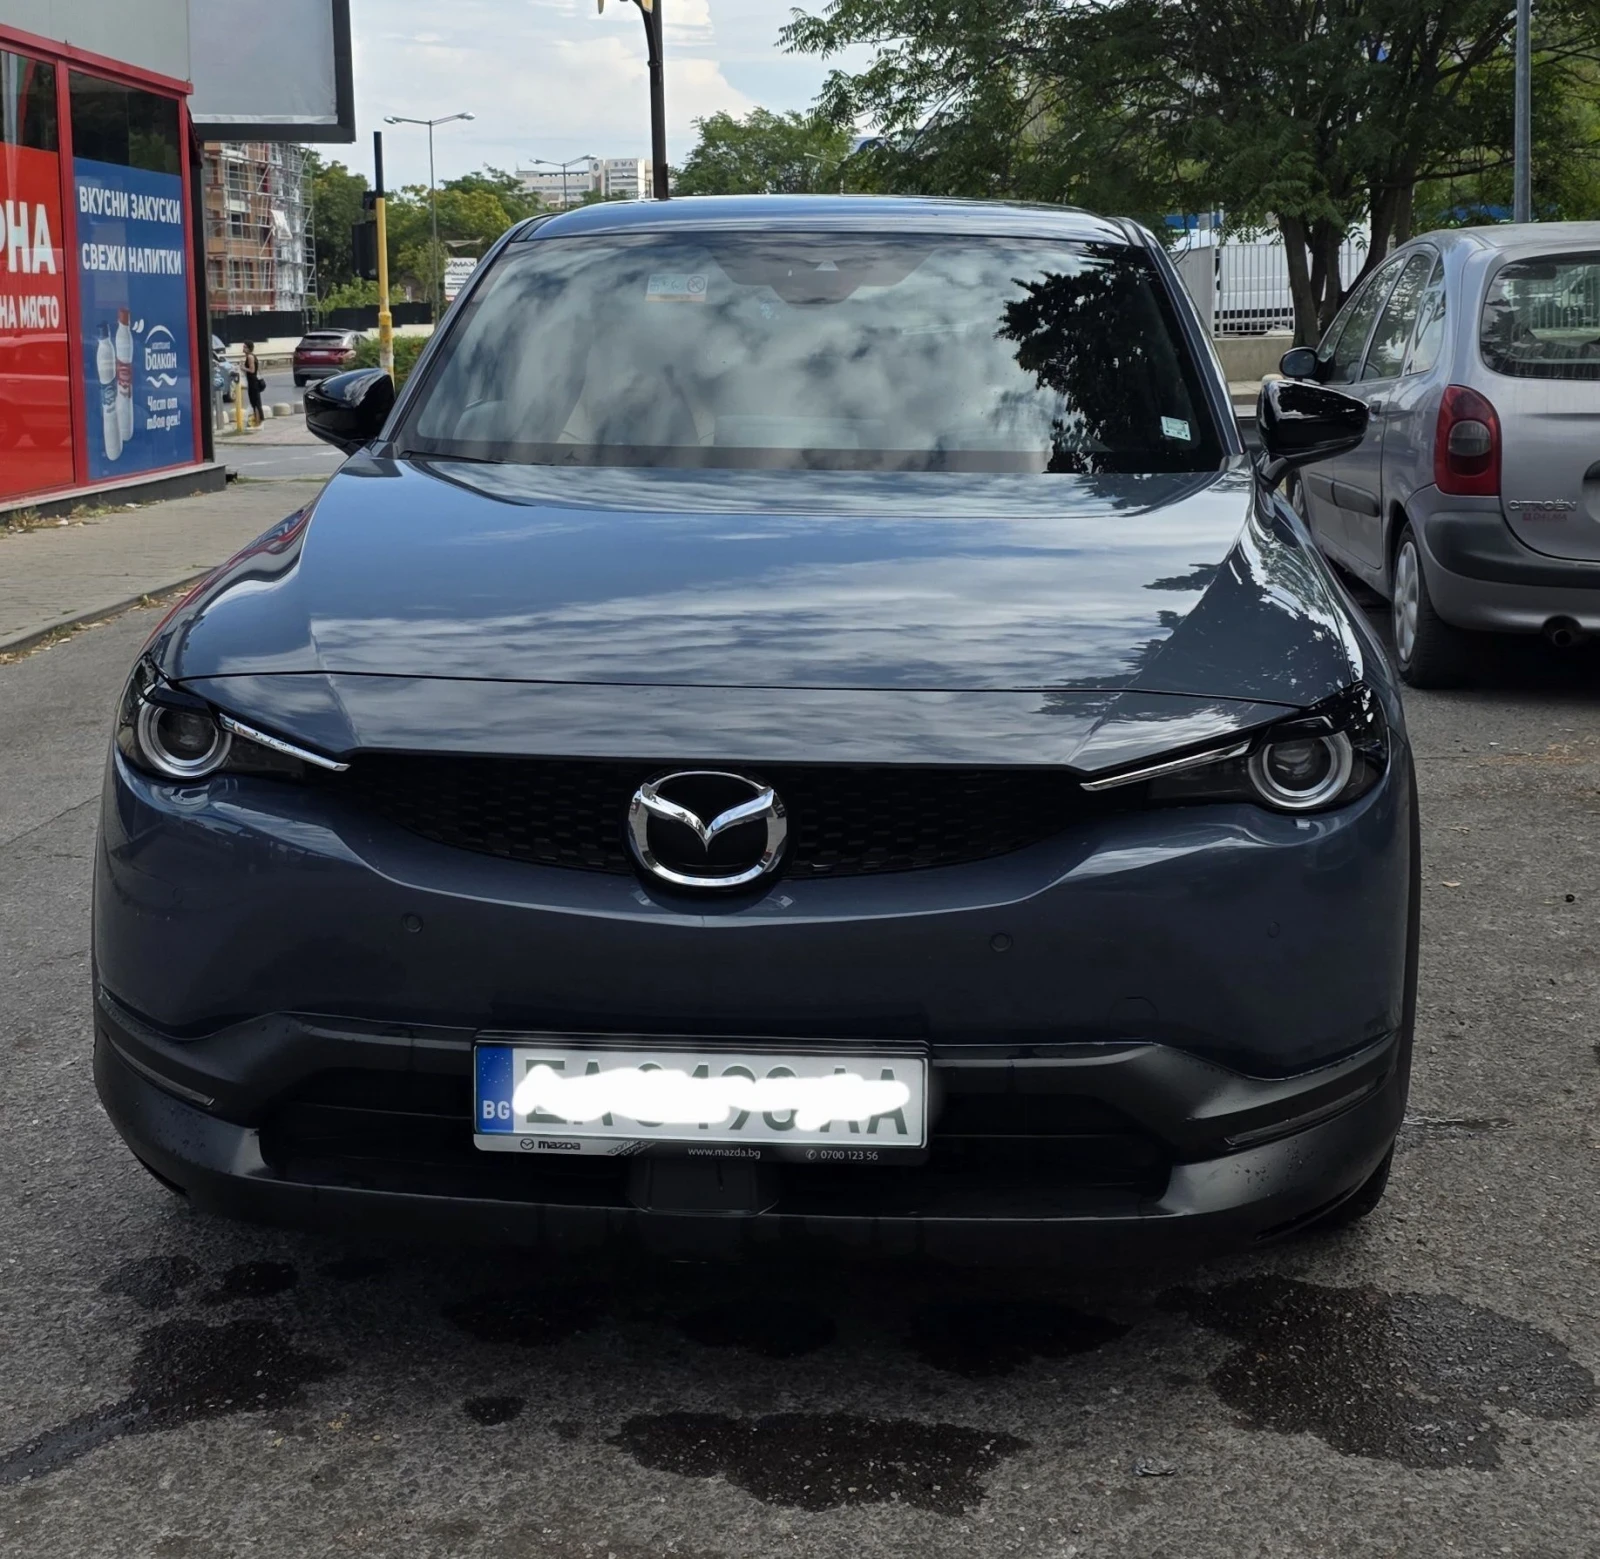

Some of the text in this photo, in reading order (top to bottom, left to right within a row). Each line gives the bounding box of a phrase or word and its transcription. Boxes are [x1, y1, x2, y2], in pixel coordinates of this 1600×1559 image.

[79, 186, 181, 224] ВКУСНИ ЗАКУСКИ
[82, 243, 182, 275] СВЕЖИ НАПИТКИ
[19, 294, 59, 329] МЯСТО
[145, 348, 177, 370] Балкан
[147, 396, 178, 411] Част от
[146, 414, 165, 430] твоя
[1508, 498, 1577, 512] CITROËN
[482, 1100, 510, 1119] BG
[538, 1140, 581, 1150] mazda
[687, 1147, 761, 1160] www.mazda.bg
[820, 1151, 879, 1161] 0700 123 56
